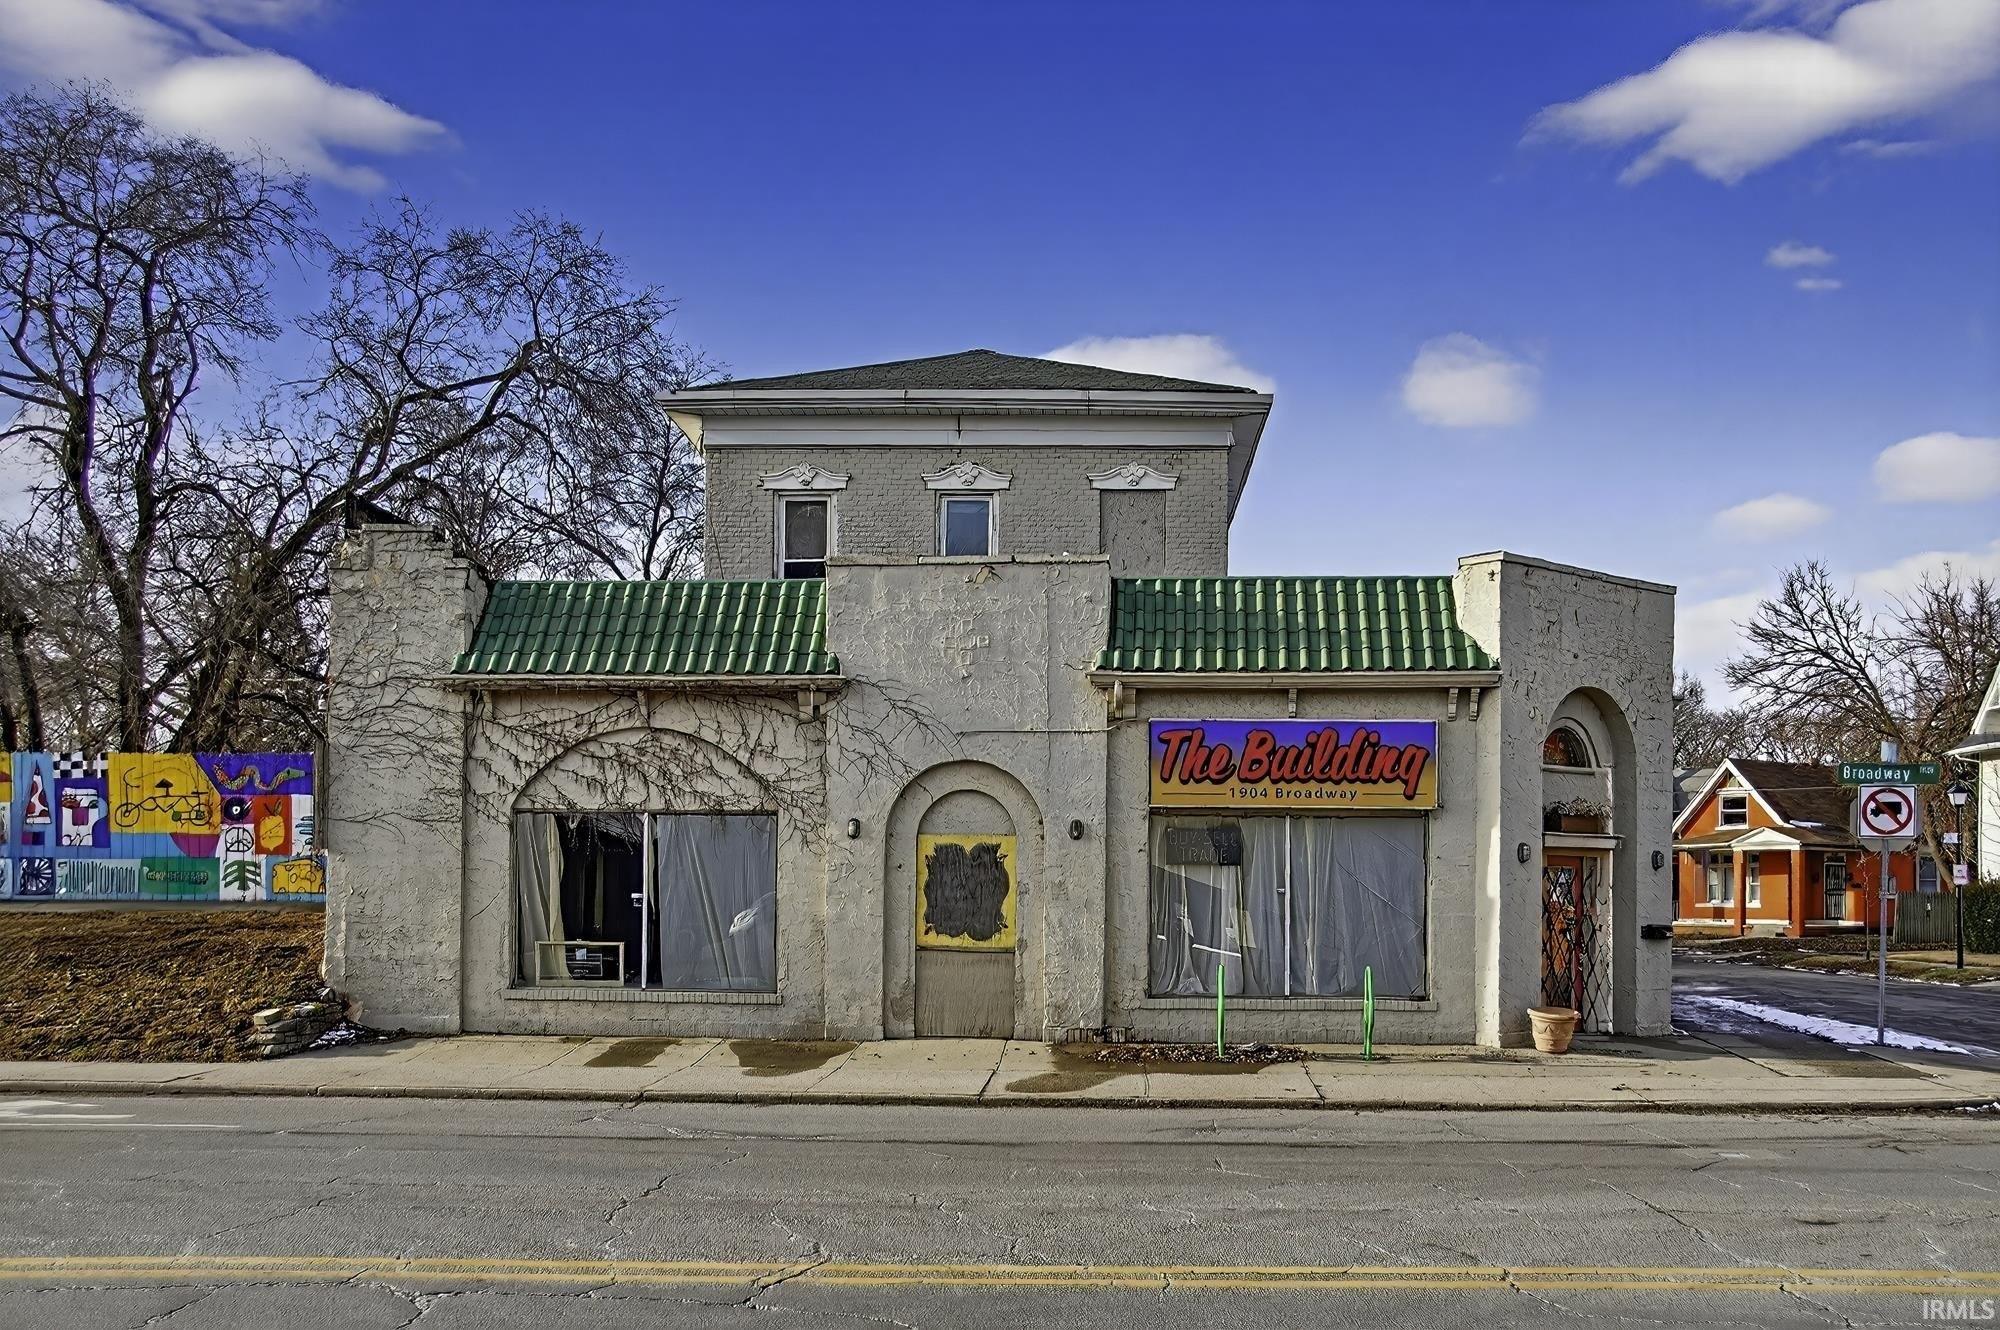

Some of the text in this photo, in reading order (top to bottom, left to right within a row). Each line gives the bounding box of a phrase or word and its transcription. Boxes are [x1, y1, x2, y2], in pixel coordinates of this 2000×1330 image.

[1158, 726, 1430, 800] The Building
[1843, 765, 1911, 782] Broadway
[1229, 787, 1358, 802] 1904 Broadway
[1180, 846, 1228, 864] TRADE
